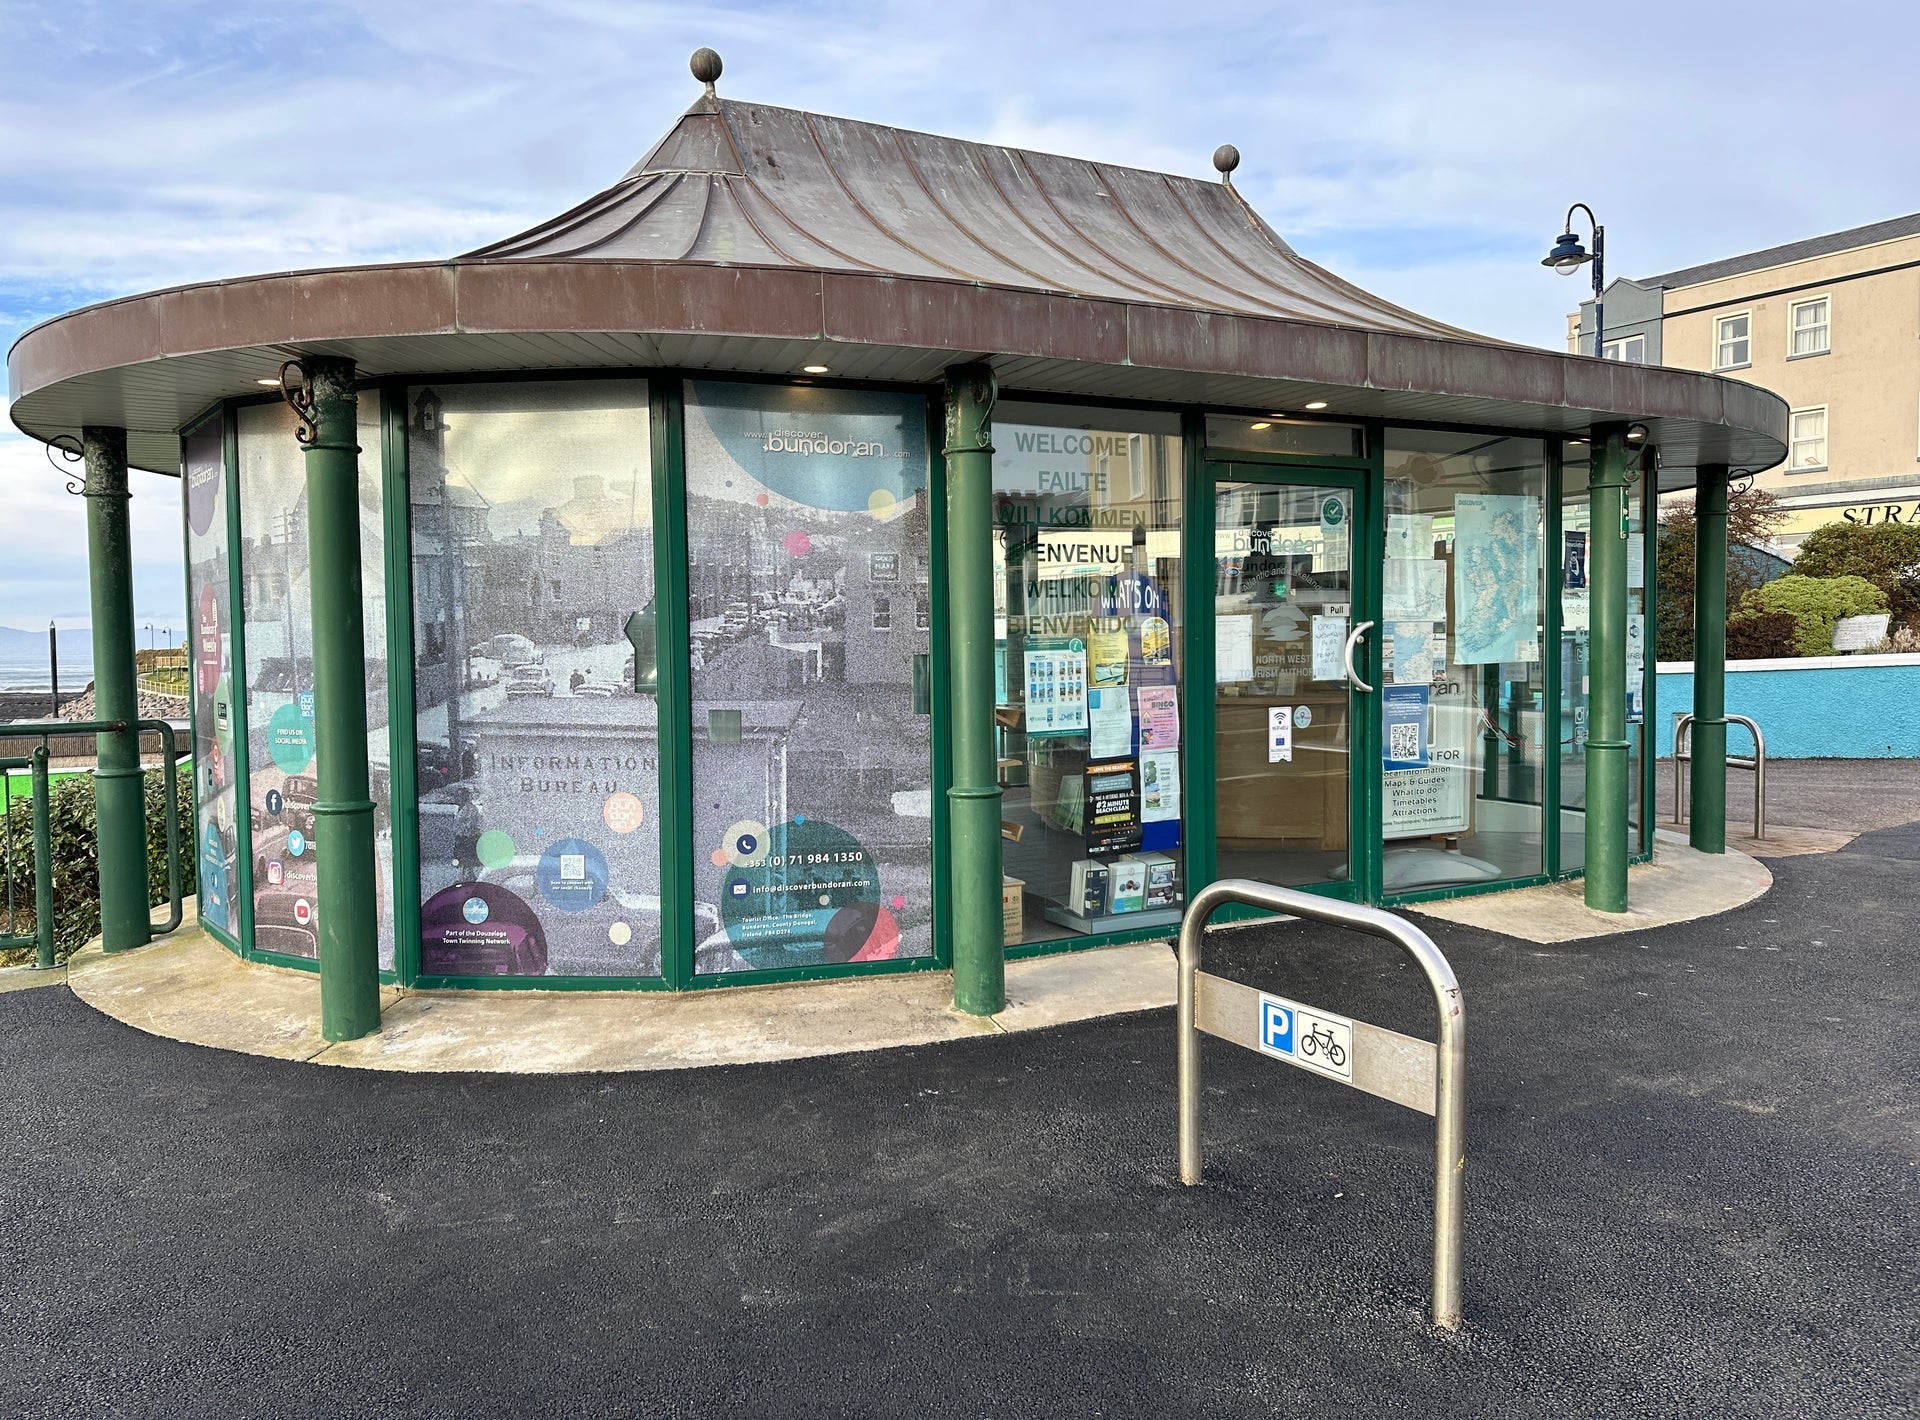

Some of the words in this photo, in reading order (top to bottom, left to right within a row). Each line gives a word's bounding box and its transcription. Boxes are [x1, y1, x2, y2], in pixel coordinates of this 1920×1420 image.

[774, 427, 823, 439] discover
[768, 432, 884, 456] bundoran
[1014, 431, 1128, 457] WELCOME
[1037, 470, 1108, 492] FAILTE
[997, 504, 1146, 527] WILLKOMMEN
[1238, 529, 1278, 538] discover
[1233, 532, 1325, 555] bundoran
[1242, 569, 1270, 593] Atlantic
[1271, 566, 1287, 575] and
[1144, 585, 1160, 608] ON
[1330, 606, 1344, 614] Pull
[1006, 615, 1138, 634] BIENVENIDO
[1255, 654, 1285, 664] NORTH
[1287, 654, 1311, 664] WEST
[1240, 668, 1278, 679] TOURISM
[1279, 667, 1328, 678] AUTHORITY
[1151, 700, 1174, 709] BINGO
[274, 737, 291, 745] SOCIAL
[1436, 749, 1460, 761] FOR
[490, 752, 656, 771] INFORMATION
[520, 776, 617, 793] BUREAU
[1384, 780, 1407, 788] Maps
[1417, 776, 1446, 785] Guides
[1392, 789, 1414, 797] What
[1427, 787, 1438, 795] do
[1096, 800, 1107, 809] #2
[1107, 799, 1130, 807] MINUTE
[1392, 797, 1437, 807] Timetables
[1391, 807, 1437, 817] Attractions
[743, 858, 766, 868] +353
[769, 856, 786, 868] (0)
[789, 855, 803, 865] 71
[807, 853, 830, 864] 984
[833, 851, 863, 863] 1350
[284, 869, 317, 882] /discoverb
[753, 880, 871, 894] info@discoverbundoran.com
[458, 938, 485, 946] Twinning
[1266, 1007, 1290, 1046] P
